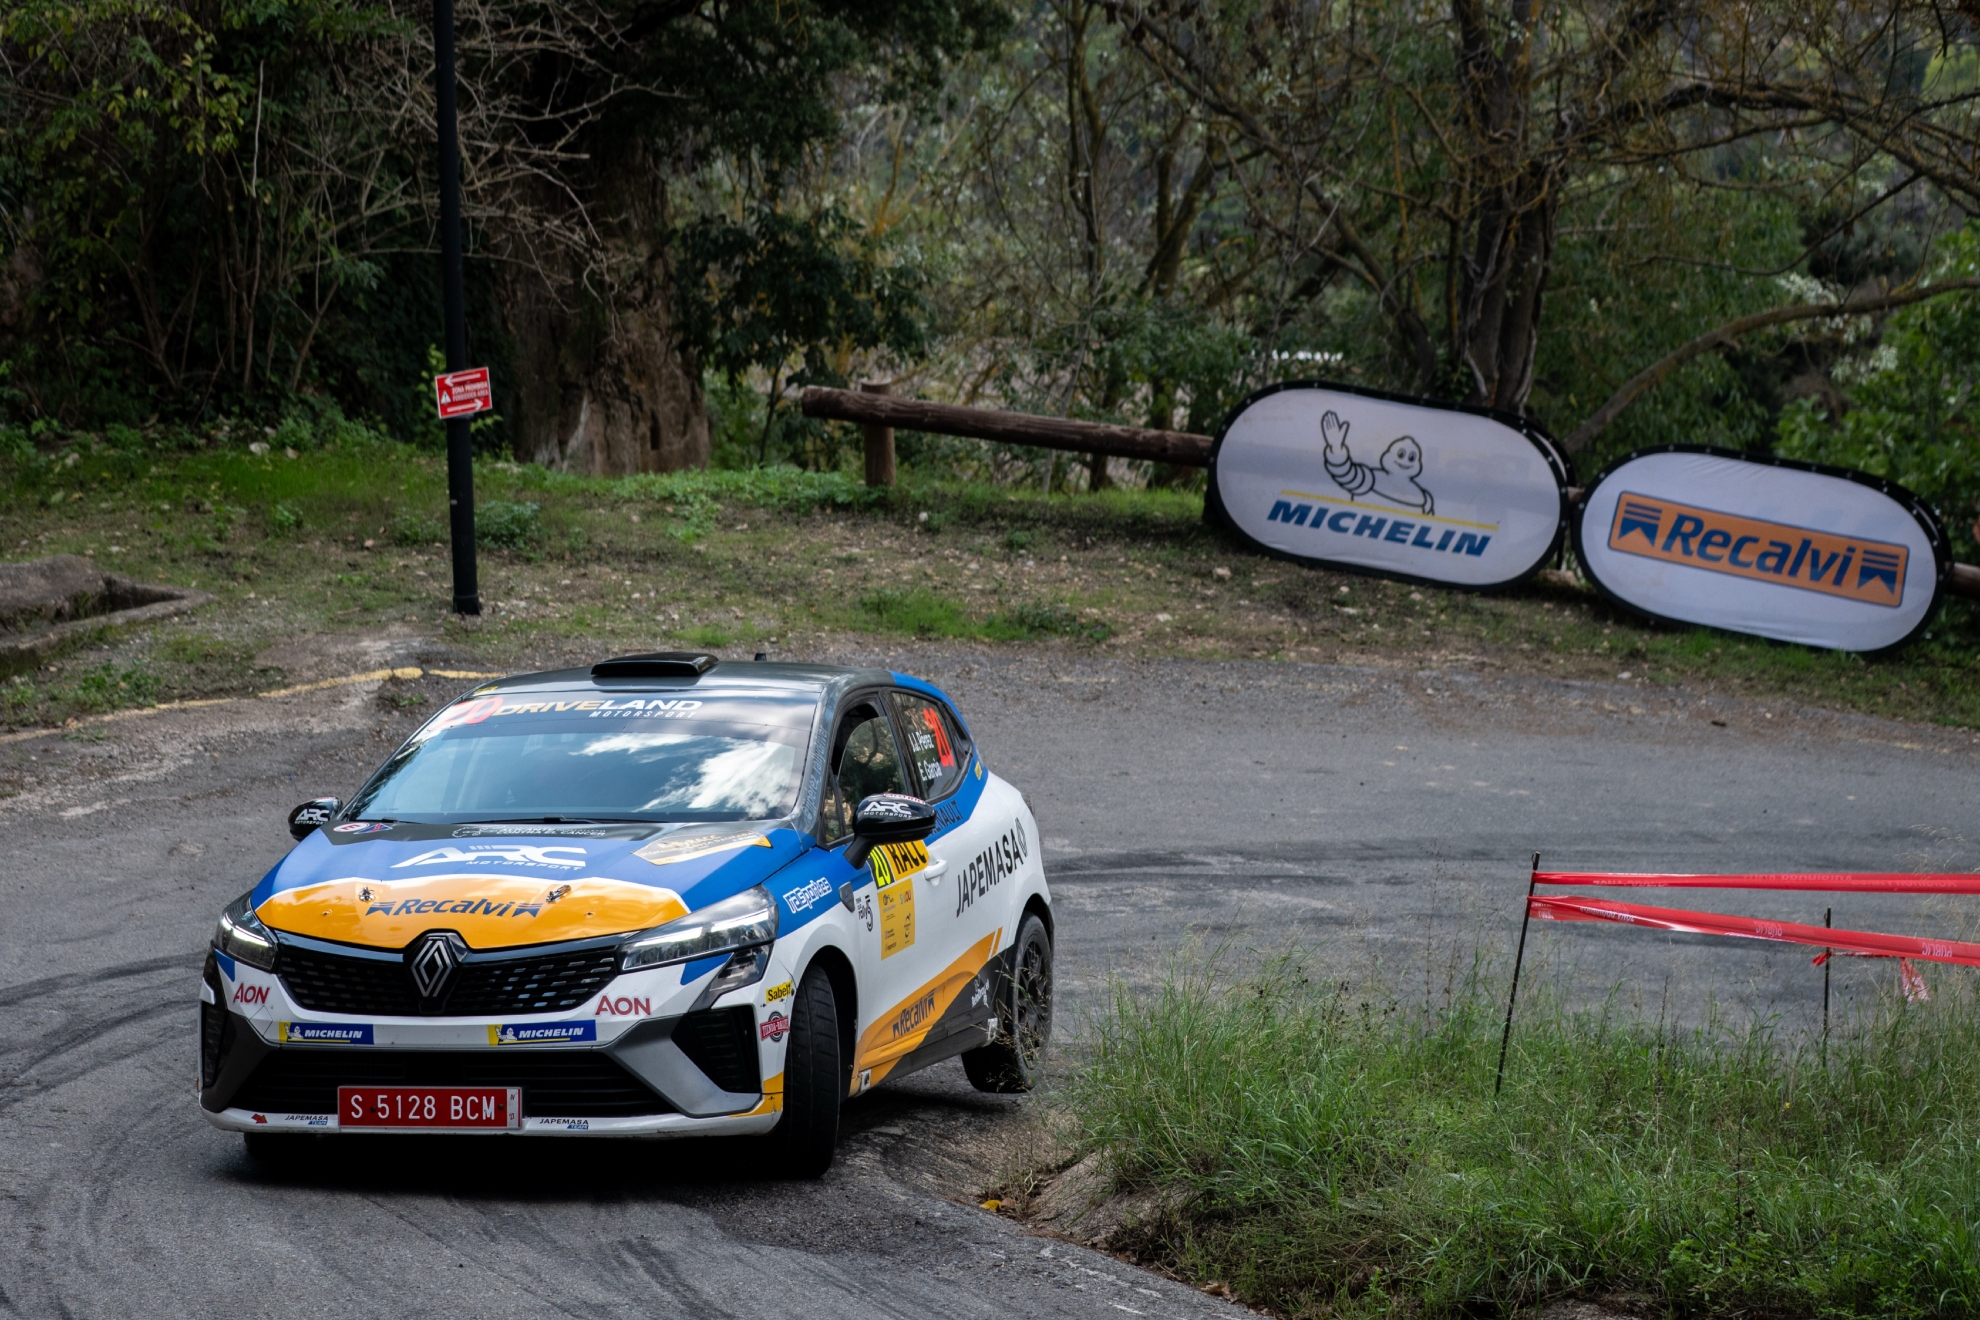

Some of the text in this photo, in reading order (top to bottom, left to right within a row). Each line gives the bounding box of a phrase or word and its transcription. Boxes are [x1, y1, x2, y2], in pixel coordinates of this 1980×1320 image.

[1266, 500, 1492, 557] MICHELIN
[1661, 513, 1856, 587] Recalvi
[491, 700, 702, 717] DRIVELAND
[589, 711, 696, 719] MOTORSPORT
[923, 708, 954, 767] 20
[295, 808, 329, 821] ARC
[864, 811, 912, 819] MOTORSPORT
[865, 801, 912, 814] ARC
[390, 844, 587, 868] ARC
[466, 860, 585, 871] MOTORSPORT
[869, 846, 891, 887] 20
[956, 829, 1024, 918] JAPEMASA
[393, 899, 516, 917] Recalvi
[233, 983, 271, 1004] AON
[767, 982, 792, 1003] Sabelt
[595, 995, 651, 1016] AON
[304, 1029, 363, 1039] MICHELIN
[518, 1027, 584, 1039] MICHELIN
[351, 1094, 495, 1121] S 5128 BCM
